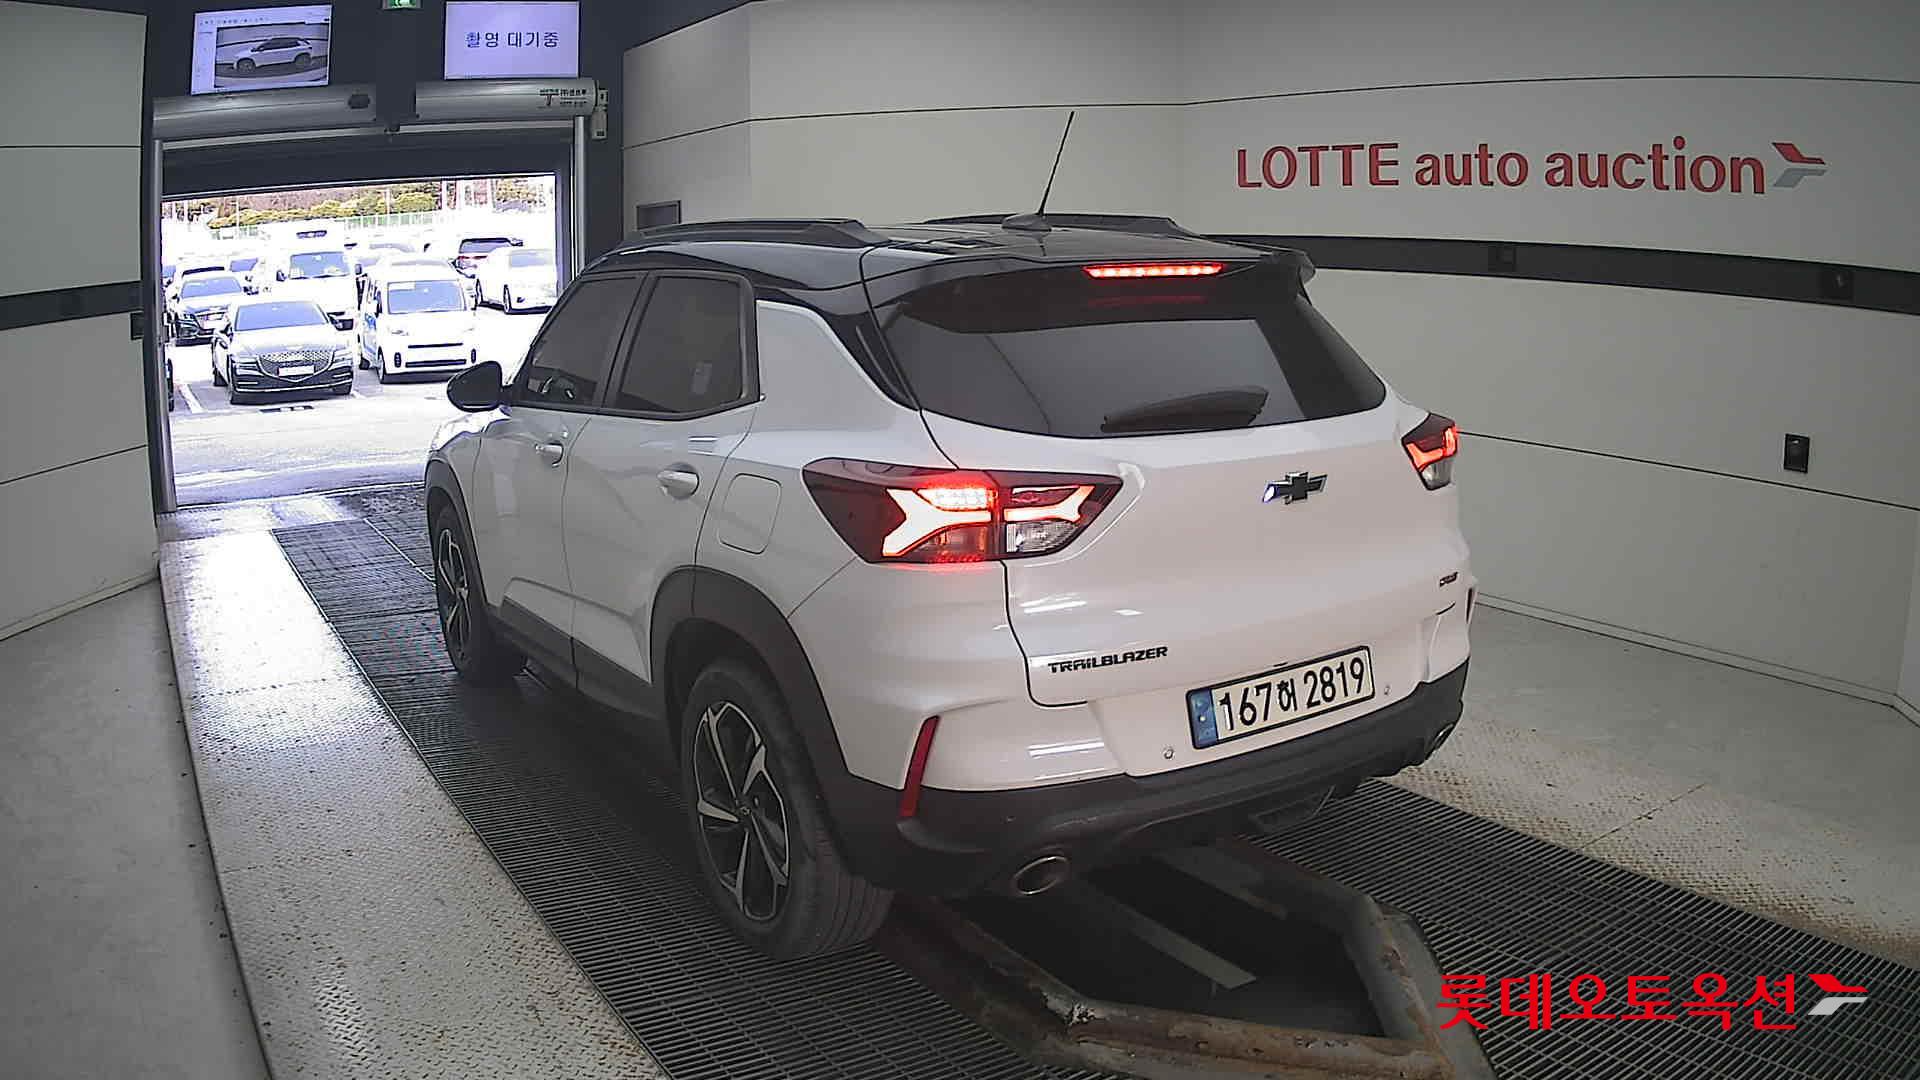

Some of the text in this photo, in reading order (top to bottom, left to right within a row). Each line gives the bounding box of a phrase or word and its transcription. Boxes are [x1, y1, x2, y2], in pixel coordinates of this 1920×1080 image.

[507, 31, 560, 48] 대기중
[1236, 136, 1766, 194] LOTTE auto auction
[1047, 646, 1168, 673] TRAILBLAZER
[1303, 656, 1364, 709] 2819
